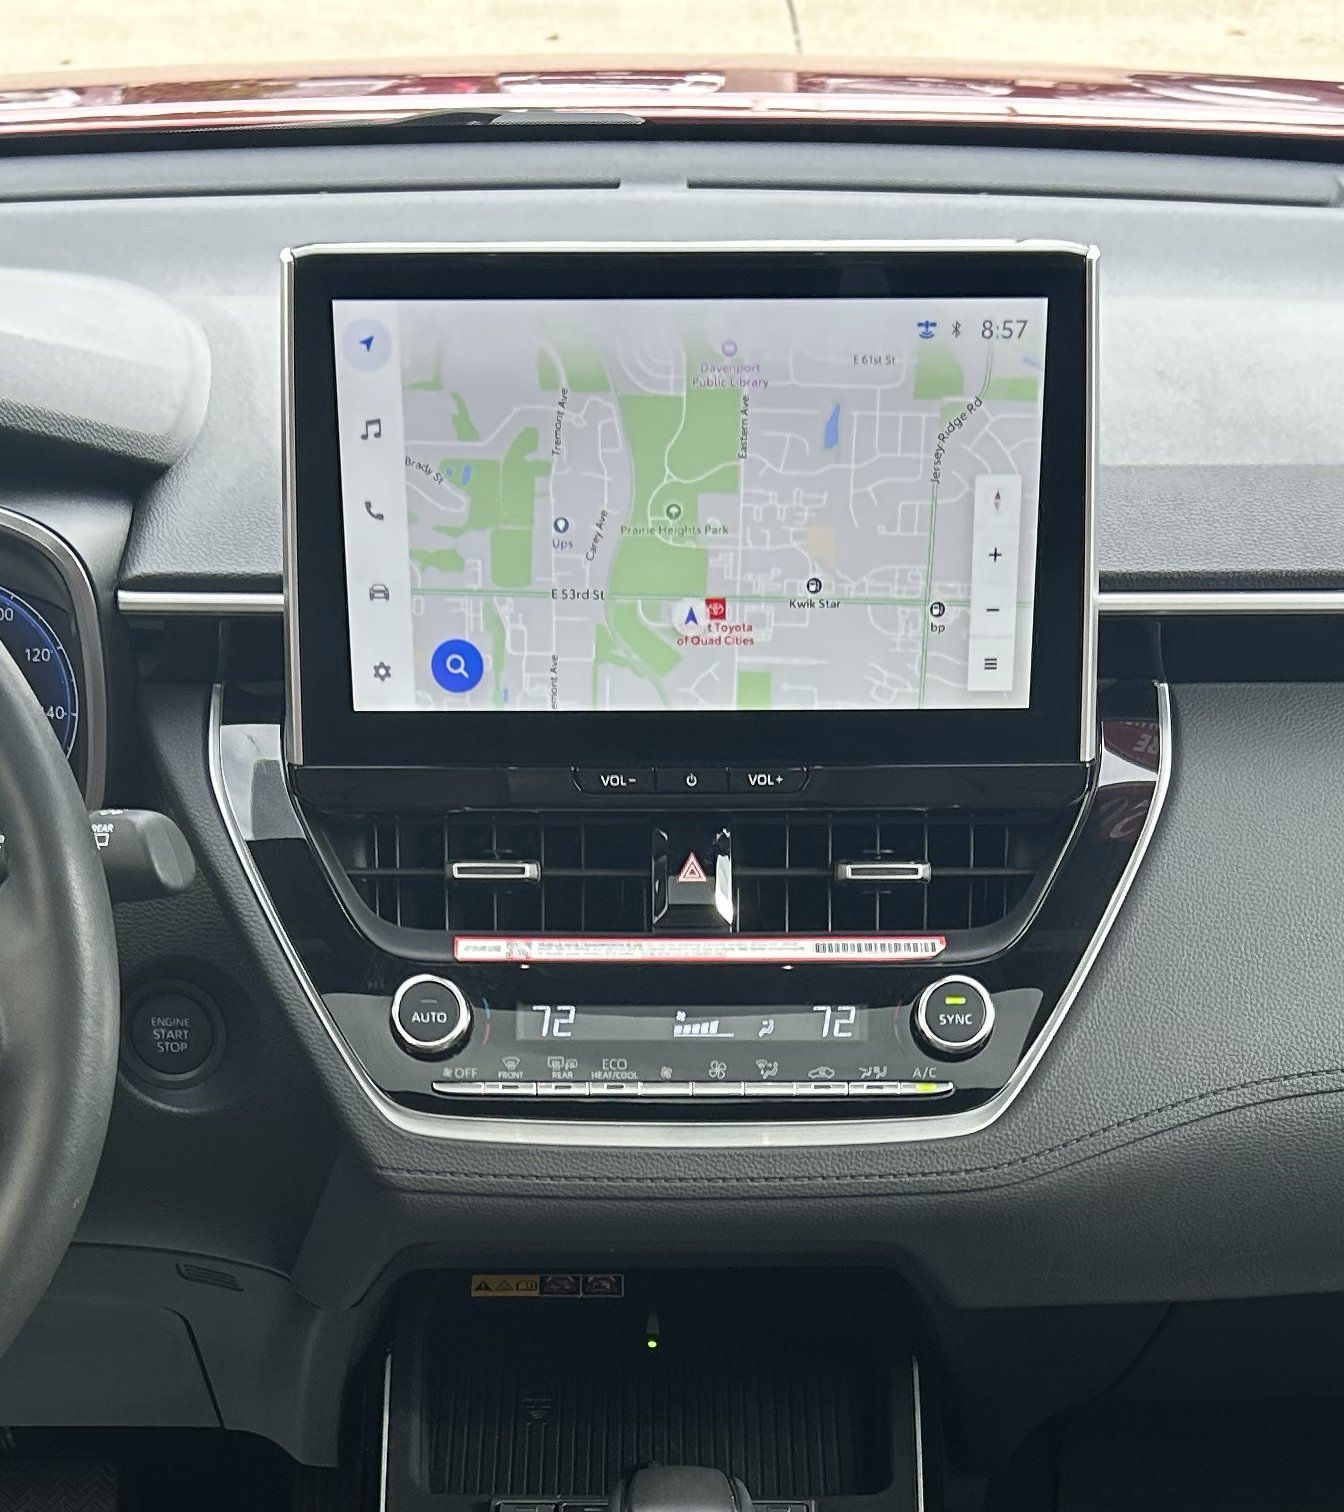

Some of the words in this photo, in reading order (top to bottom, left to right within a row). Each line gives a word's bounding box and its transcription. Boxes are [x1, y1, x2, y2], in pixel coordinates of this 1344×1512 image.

[981, 320, 1028, 339] 8:57
[853, 355, 858, 365] E
[862, 355, 882, 365] 61st
[884, 355, 896, 365] St
[700, 363, 761, 375] Davenport
[692, 377, 727, 388] Public
[730, 377, 769, 390] Library
[557, 387, 569, 409] Ave
[740, 395, 750, 415] Ave
[966, 395, 983, 415] Rd
[551, 410, 565, 456] Tremont
[937, 410, 968, 445] Ridge
[738, 416, 749, 460] Eastern
[930, 443, 945, 485] Jersey
[404, 456, 434, 477] Brady
[432, 470, 445, 486] St
[586, 529, 602, 562] Carey
[595, 509, 608, 529] Ave
[621, 525, 656, 536] Prairie
[658, 525, 702, 538] Heights
[704, 525, 729, 536] Park
[552, 539, 574, 551] Ups
[551, 589, 558, 600] E
[561, 589, 590, 600] 53rd
[592, 589, 605, 600] St
[789, 599, 816, 609] Kwik
[818, 599, 841, 609] Star
[715, 623, 754, 635] Toyota
[930, 622, 946, 634] bp
[677, 636, 689, 646] of
[690, 636, 722, 647] Quad
[724, 636, 755, 646] Cities
[25, 648, 51, 662] 120
[551, 653, 559, 671] Ave
[150, 1016, 191, 1027] ENGINE
[411, 1011, 447, 1024] AUTO
[532, 1005, 576, 1037] 72
[812, 1005, 856, 1038] 72
[939, 1013, 973, 1026] SYNC
[152, 1028, 189, 1041] START
[157, 1041, 188, 1053] STOP
[602, 1058, 628, 1070] ECO
[455, 1067, 478, 1079] OFF
[498, 1070, 524, 1079] FRONT
[551, 1070, 574, 1079] REAR
[591, 1070, 639, 1080] HEAT/COOL
[912, 1067, 937, 1079] A/C
